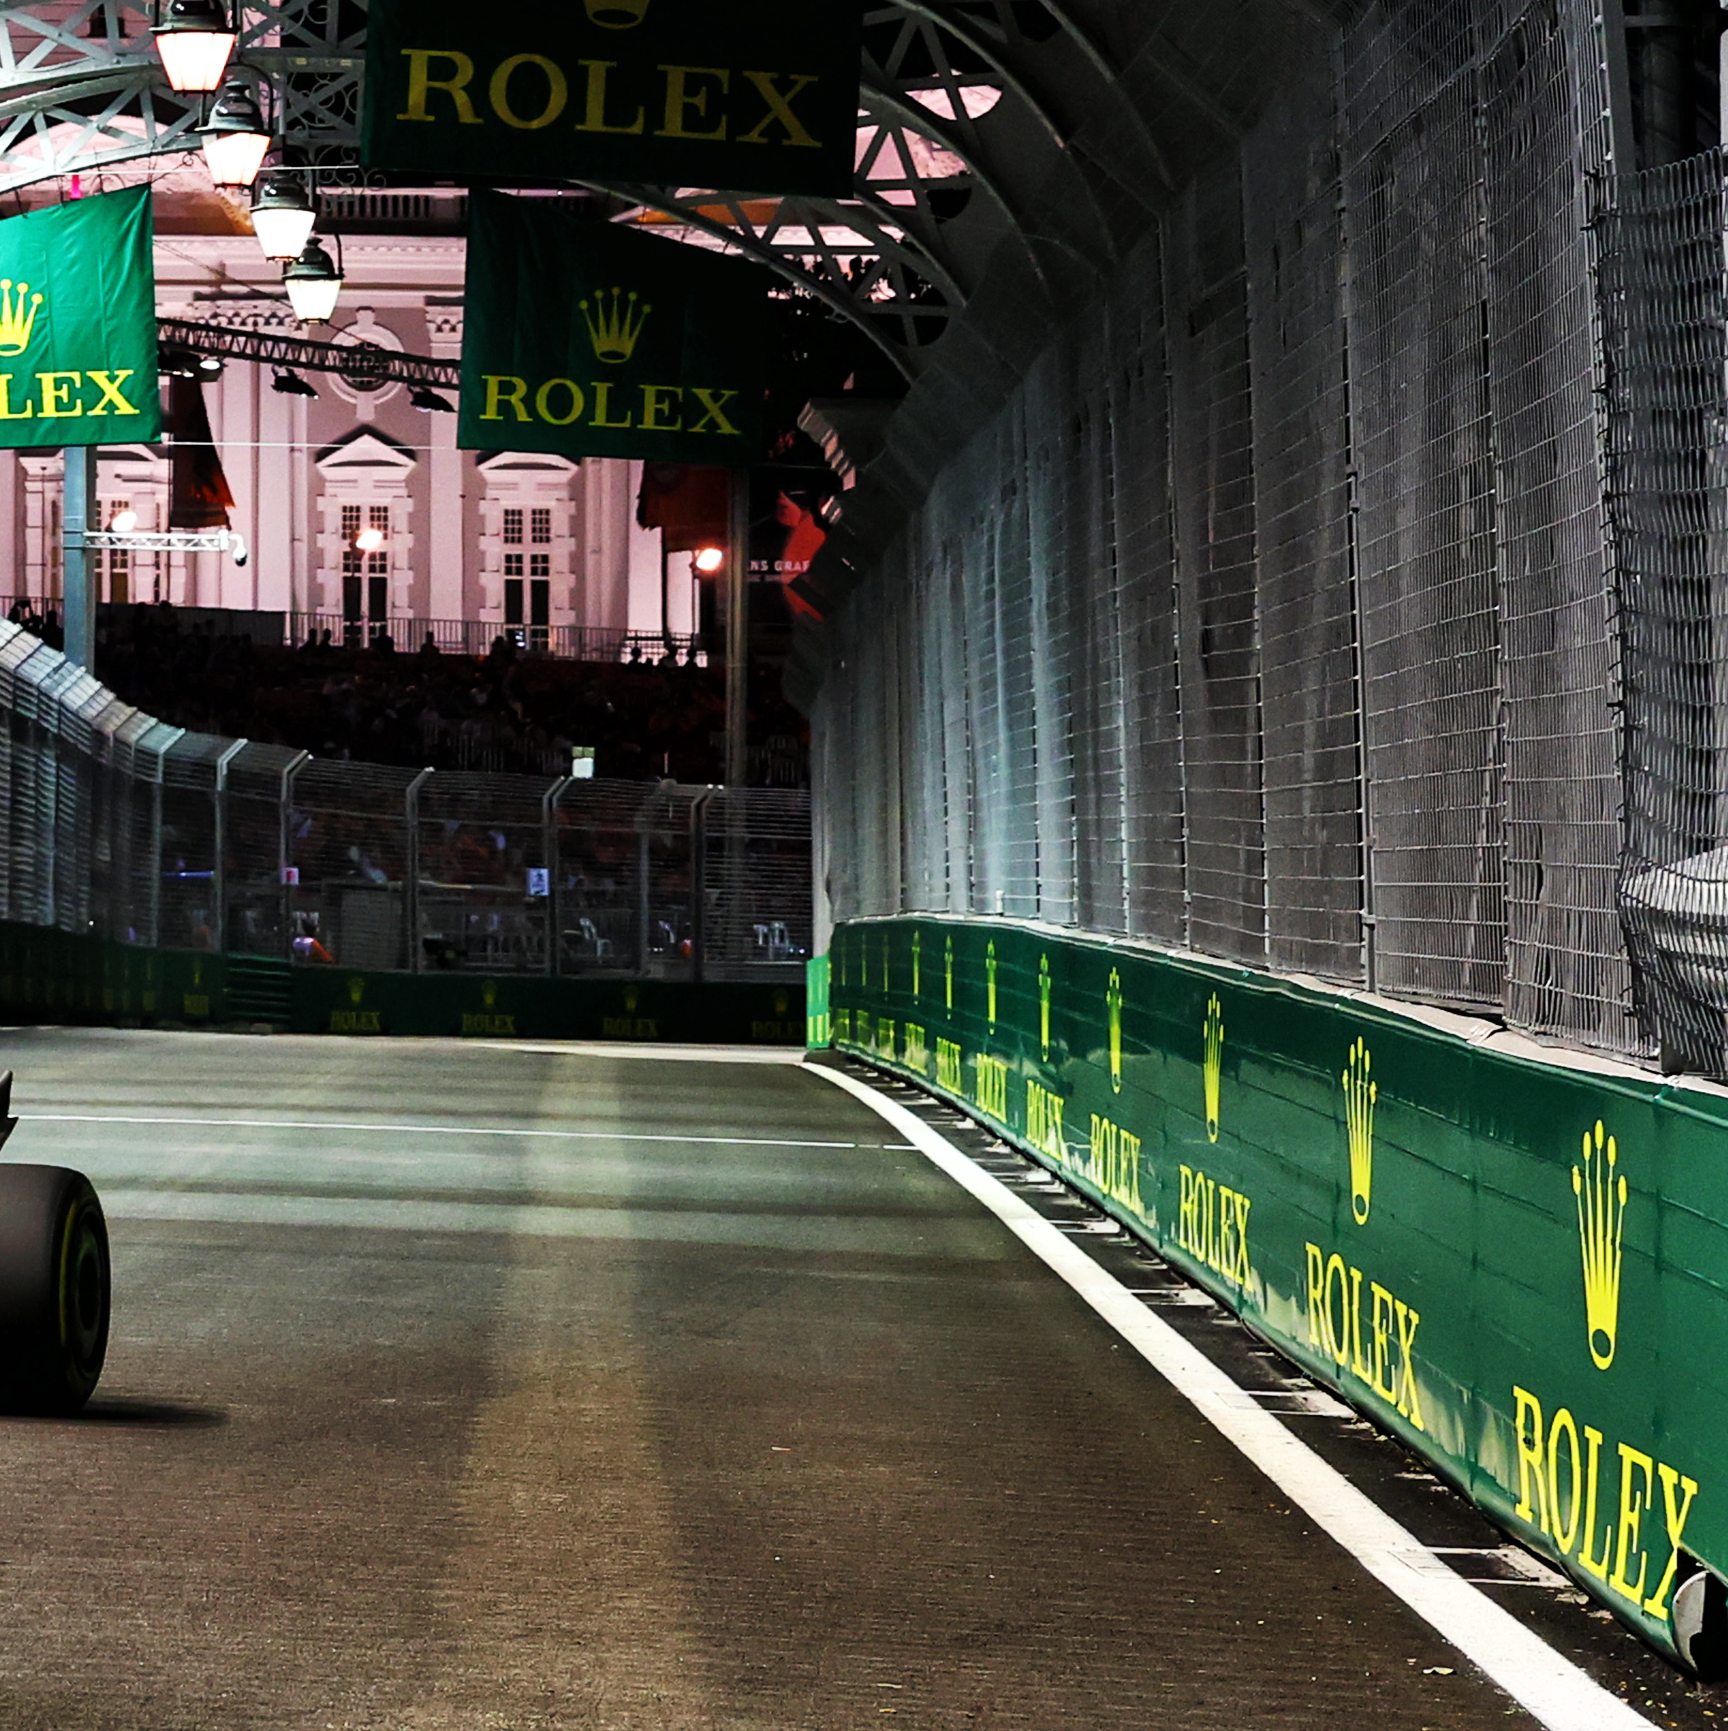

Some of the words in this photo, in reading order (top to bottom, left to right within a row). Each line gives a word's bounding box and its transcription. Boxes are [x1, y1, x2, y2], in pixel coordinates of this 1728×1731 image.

[395, 48, 822, 148] ROLEX
[479, 375, 742, 436] ROLEX
[1090, 1113, 1144, 1215] ROLEX
[1178, 1164, 1252, 1290] ROLEX
[1305, 1242, 1427, 1431] ROLEX
[1512, 1385, 1699, 1621] ROLEX
